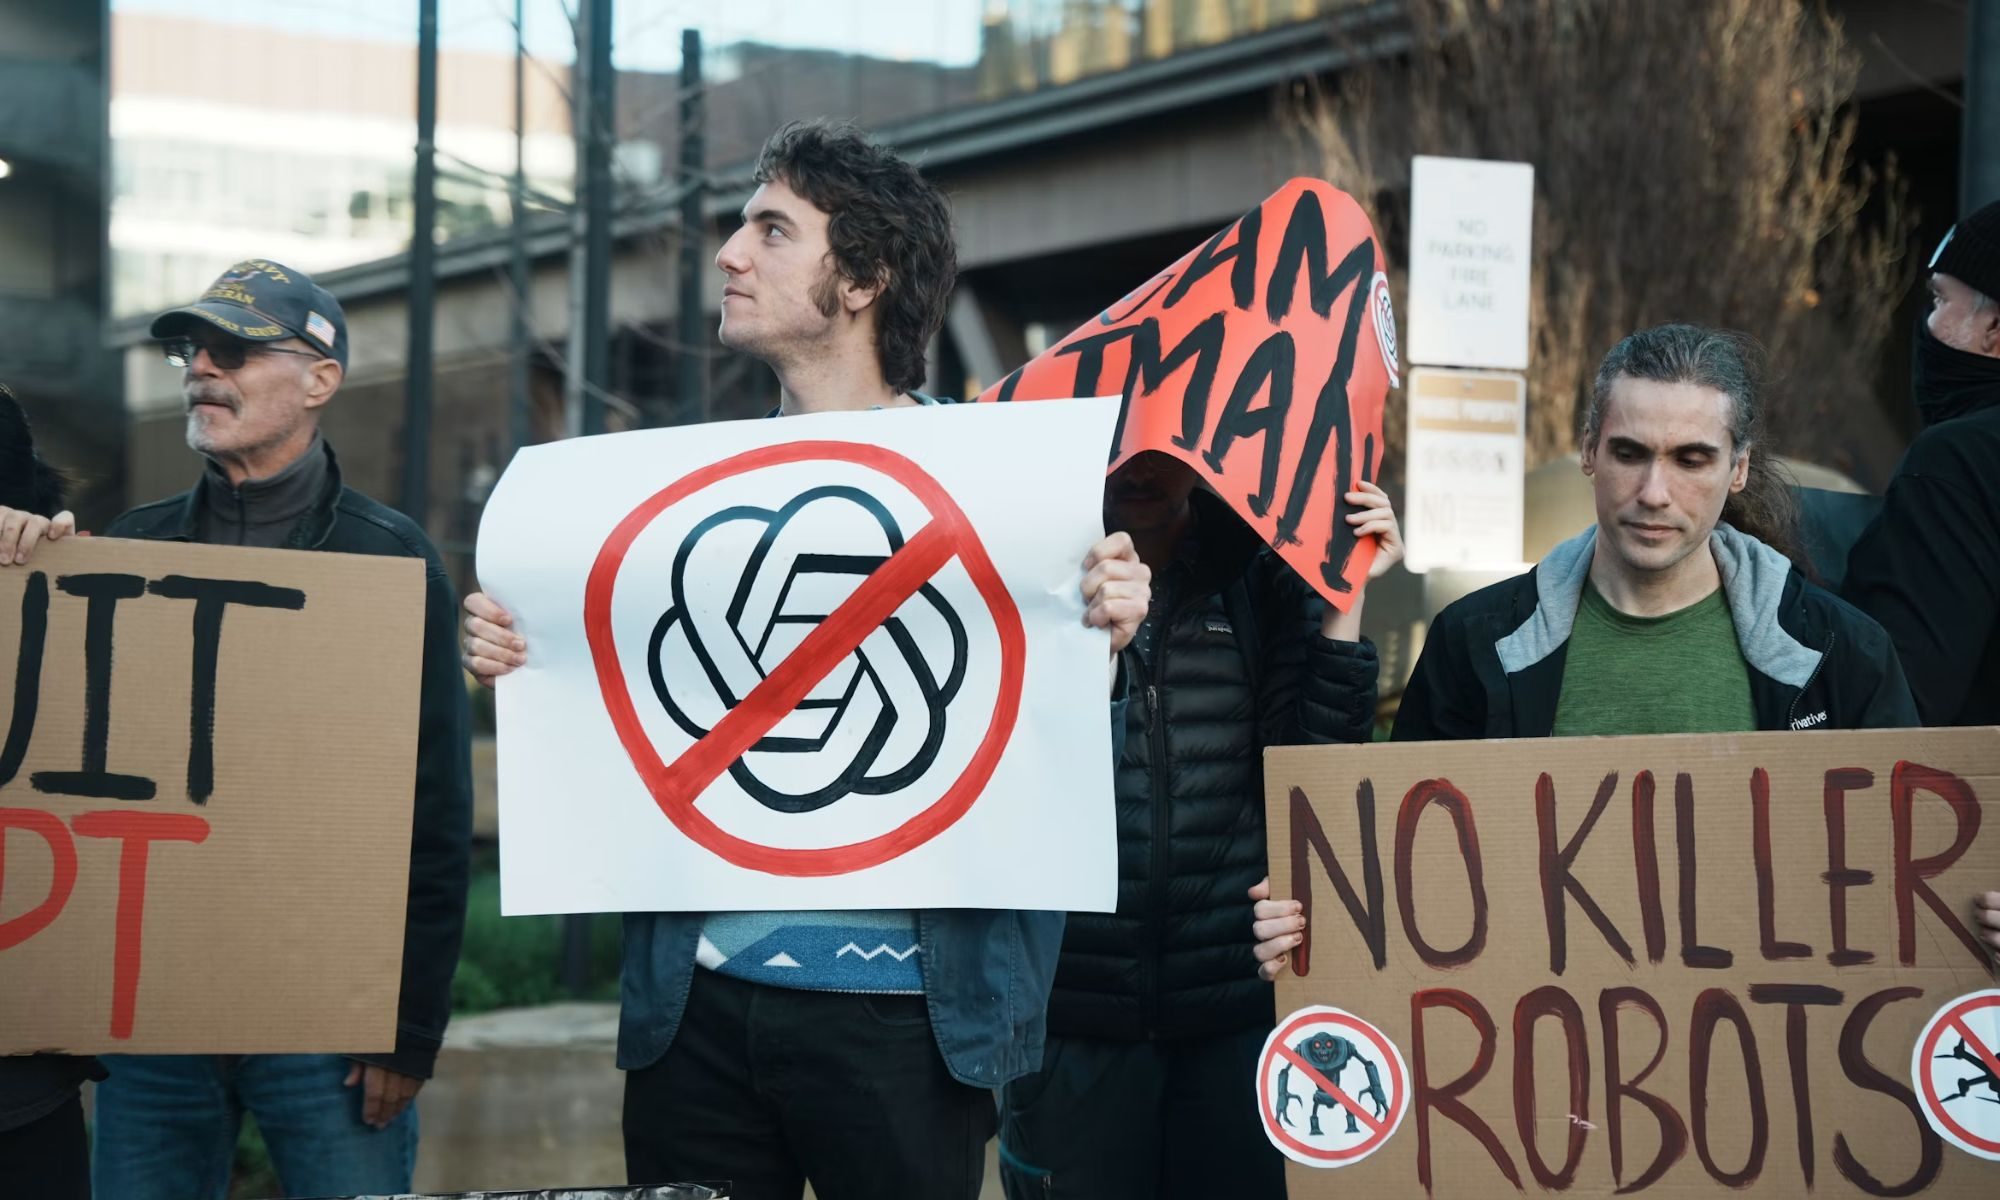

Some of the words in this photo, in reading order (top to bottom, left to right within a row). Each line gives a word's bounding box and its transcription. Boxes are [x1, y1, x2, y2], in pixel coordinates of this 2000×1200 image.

[1428, 240, 1515, 264] PARKING
[1450, 265, 1490, 288] FIRE
[1457, 217, 1488, 239] NO
[1101, 189, 1375, 385] AM
[1442, 291, 1496, 312] LANE
[970, 310, 1376, 594] TMAN
[1290, 777, 1487, 977] NO
[1536, 760, 1996, 981] KILLER
[1411, 984, 1943, 1199] ROBOTS
